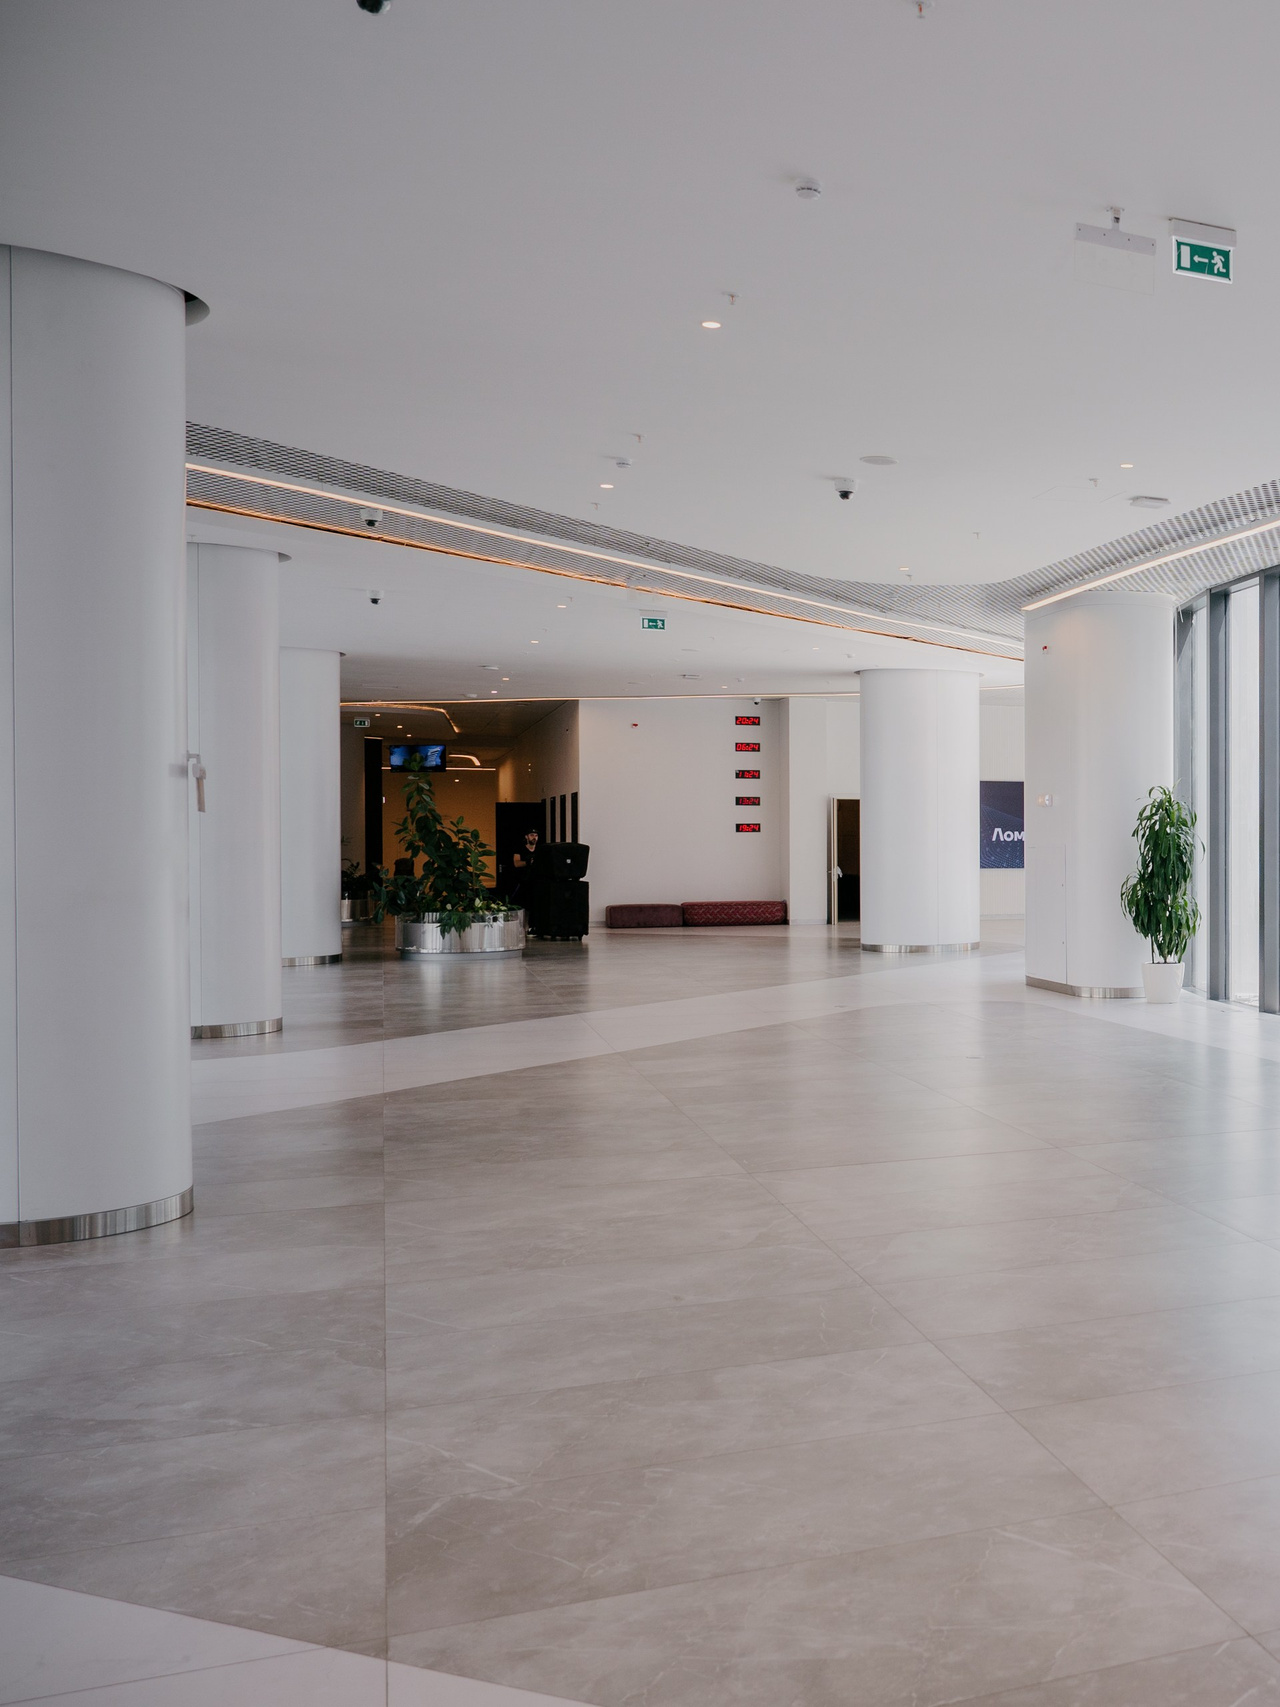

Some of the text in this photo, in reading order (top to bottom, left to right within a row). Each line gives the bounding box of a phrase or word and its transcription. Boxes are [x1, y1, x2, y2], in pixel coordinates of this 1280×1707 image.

[735, 716, 760, 725] 20:24
[735, 743, 760, 752] 06:24
[738, 797, 760, 805] 13:24
[738, 824, 760, 832] 19:24
